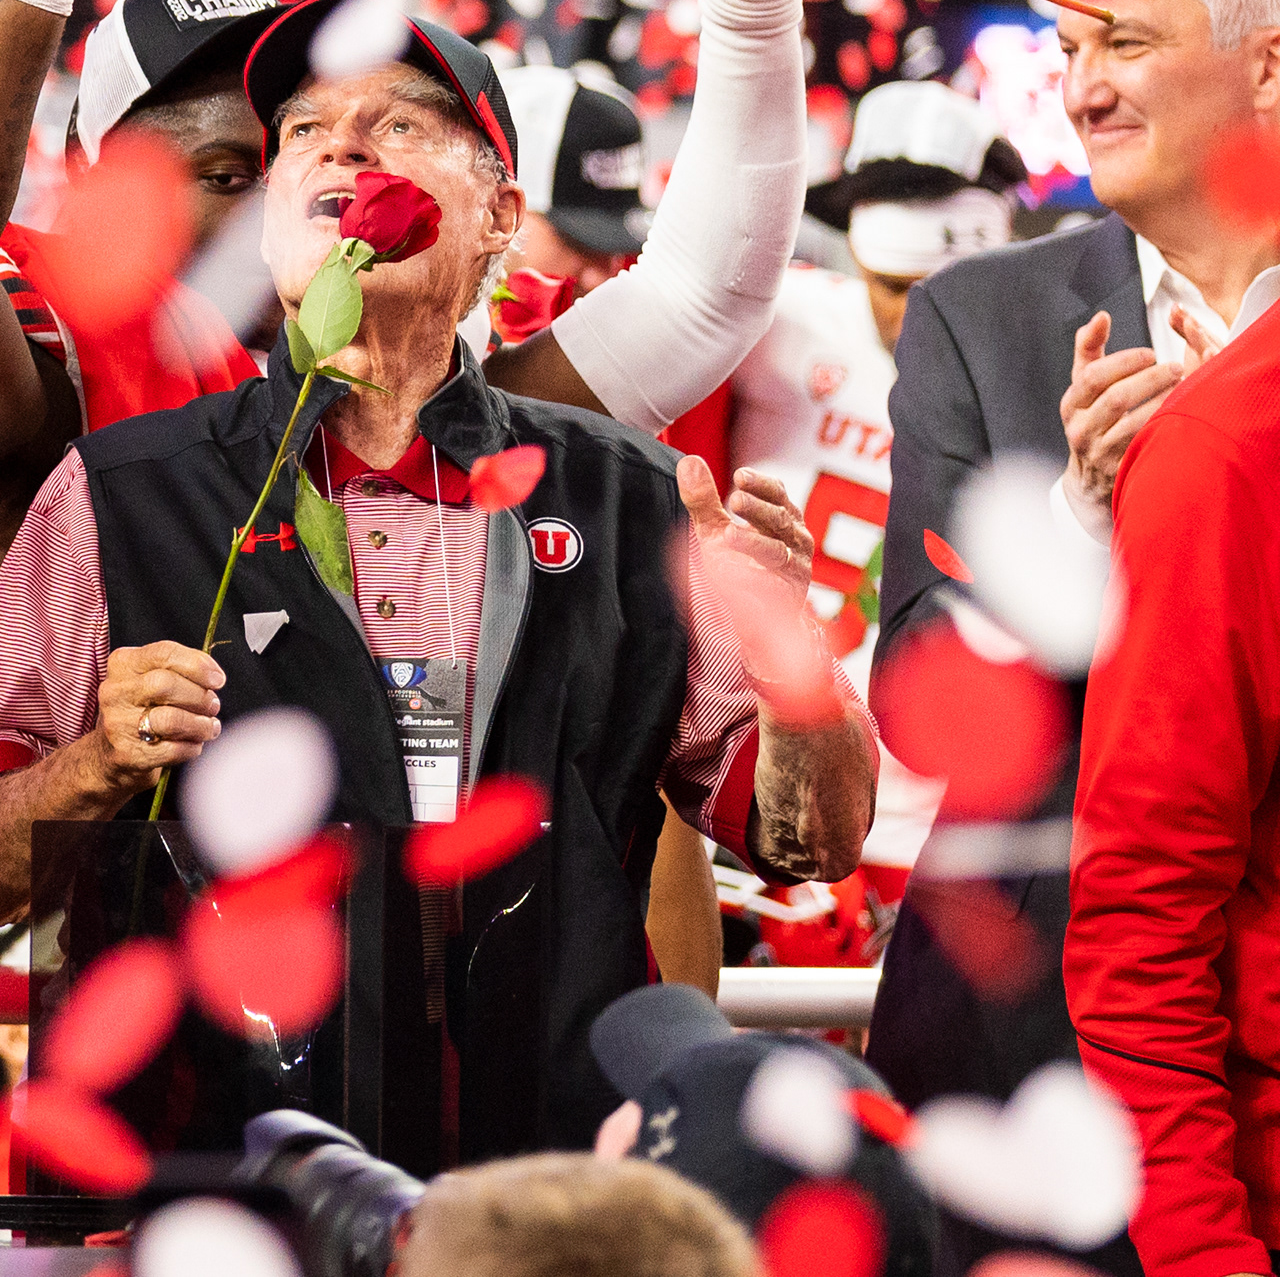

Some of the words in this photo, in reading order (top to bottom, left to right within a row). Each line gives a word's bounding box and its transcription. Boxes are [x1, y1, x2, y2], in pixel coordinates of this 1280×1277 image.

[531, 529, 570, 564] U
[422, 717, 454, 726] stadium
[428, 739, 459, 749] TEAM
